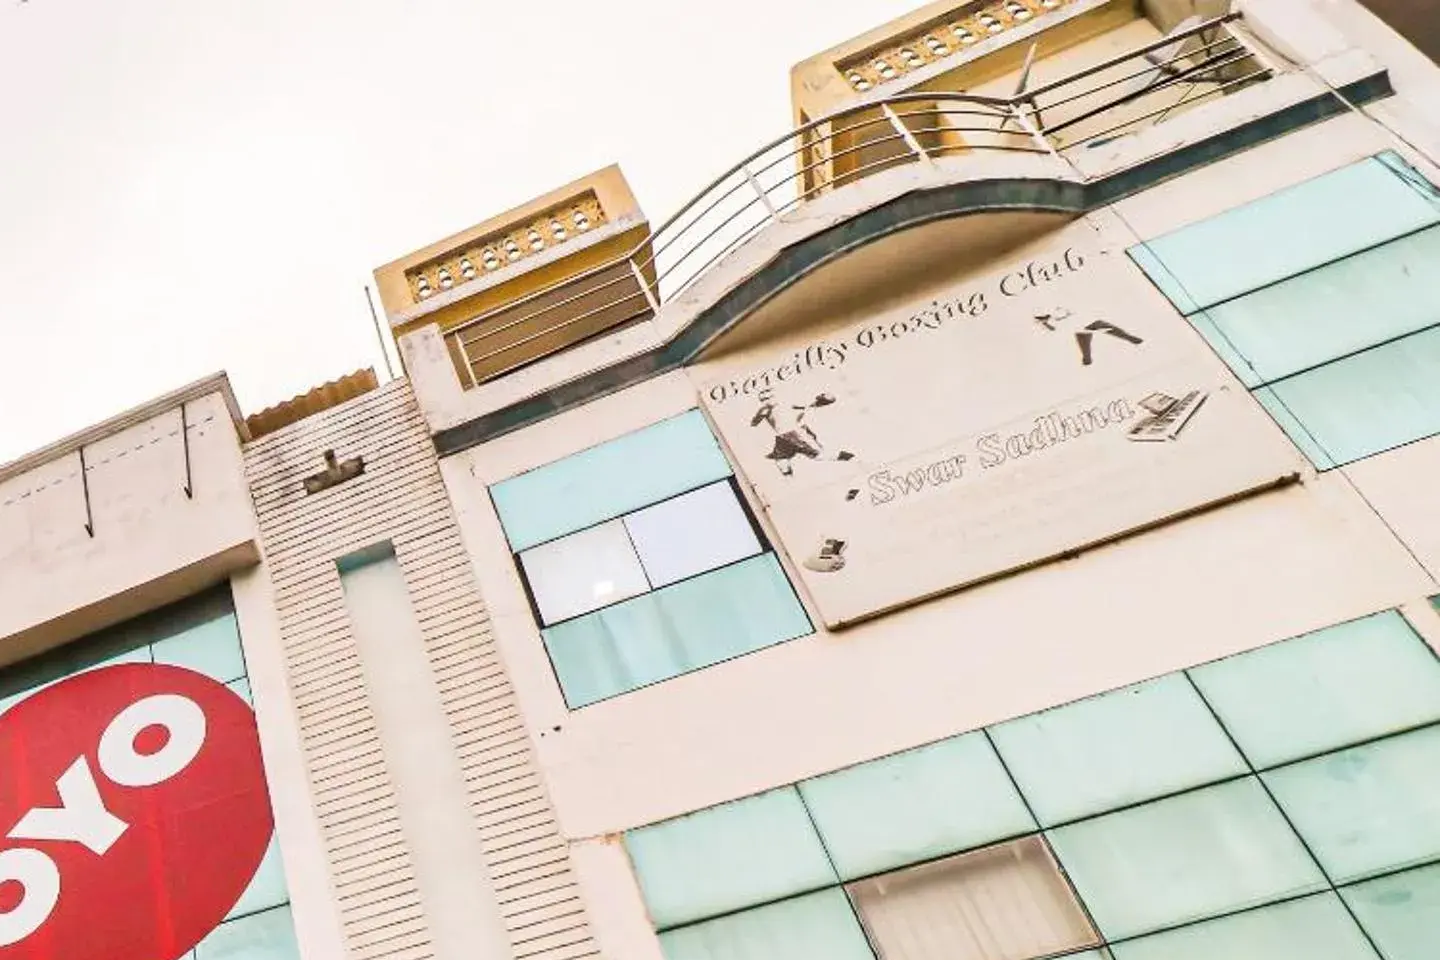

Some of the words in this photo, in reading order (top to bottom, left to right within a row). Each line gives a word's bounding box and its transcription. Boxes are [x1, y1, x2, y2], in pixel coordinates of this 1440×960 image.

[856, 293, 989, 349] Boxing
[999, 248, 1084, 298] Club
[867, 454, 967, 507] Swar
[975, 398, 1137, 470] Sadhna
